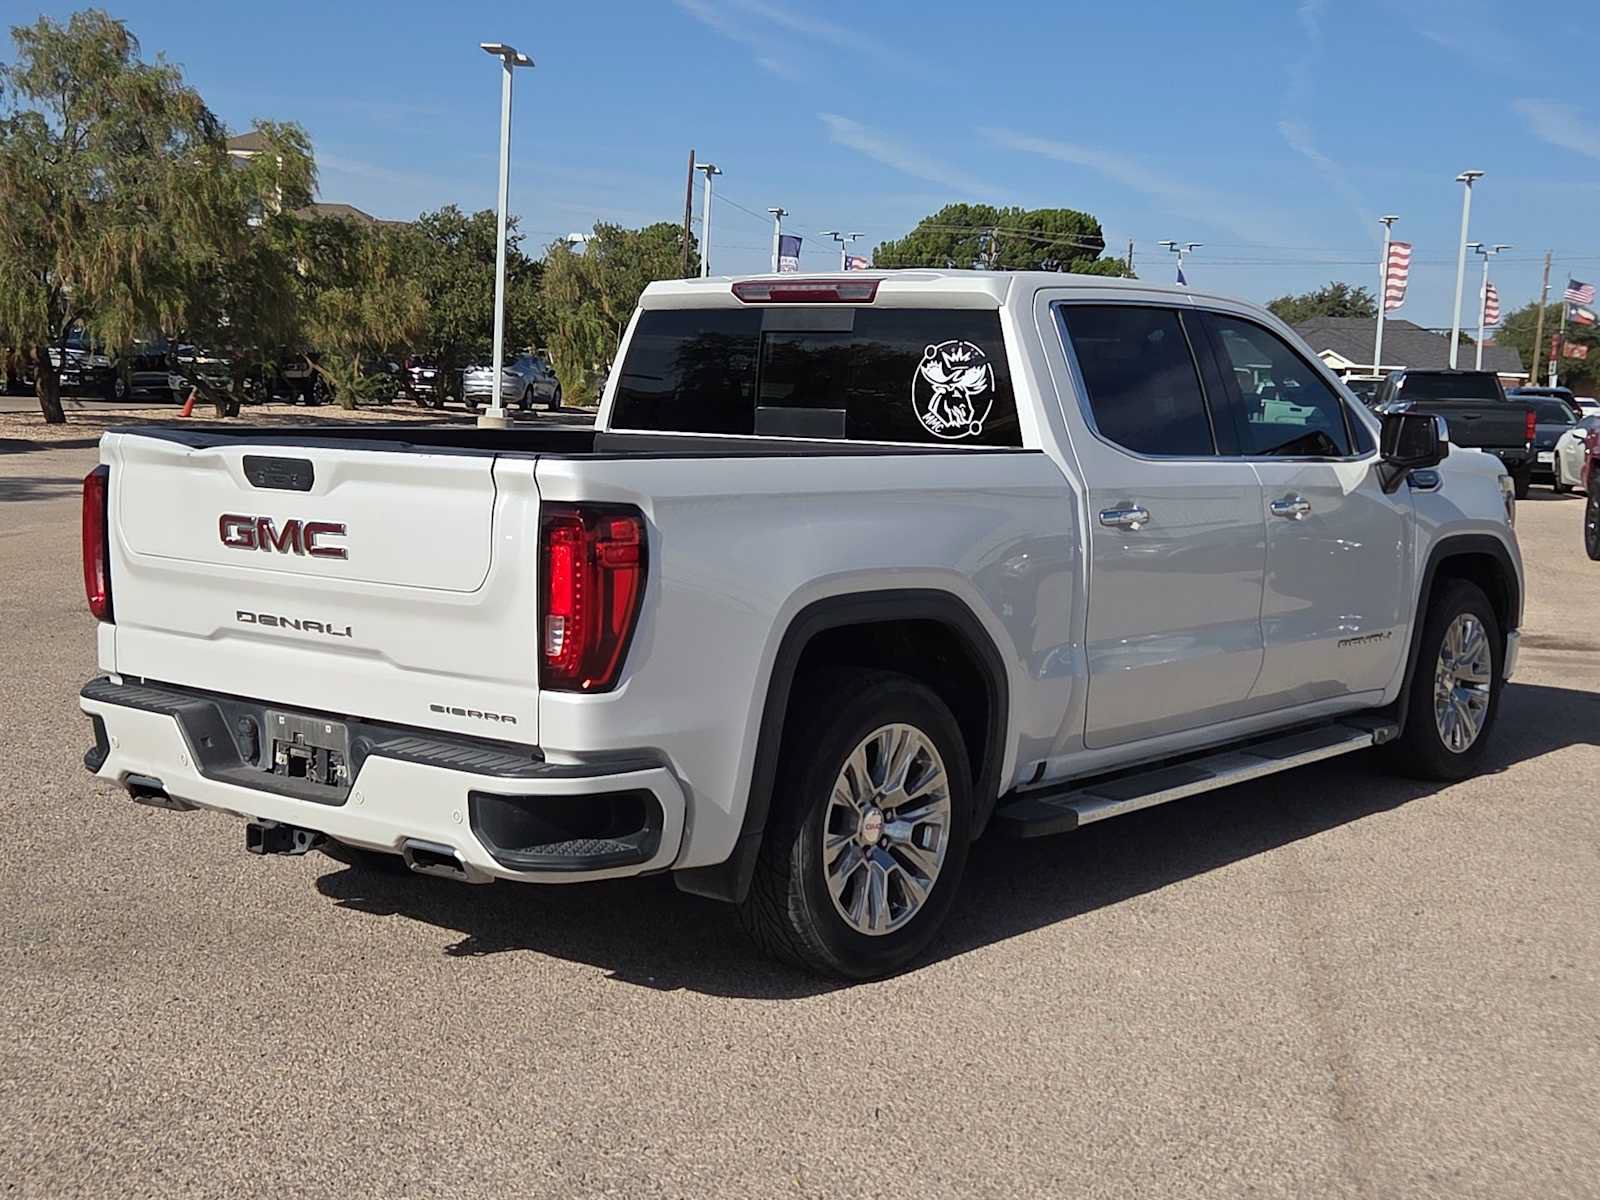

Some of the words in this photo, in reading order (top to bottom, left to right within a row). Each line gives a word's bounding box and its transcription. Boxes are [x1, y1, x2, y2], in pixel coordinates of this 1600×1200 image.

[922, 412, 944, 432] MMC
[219, 513, 348, 561] GMC
[236, 609, 352, 638] DENALI
[429, 703, 517, 725] SIERRA
